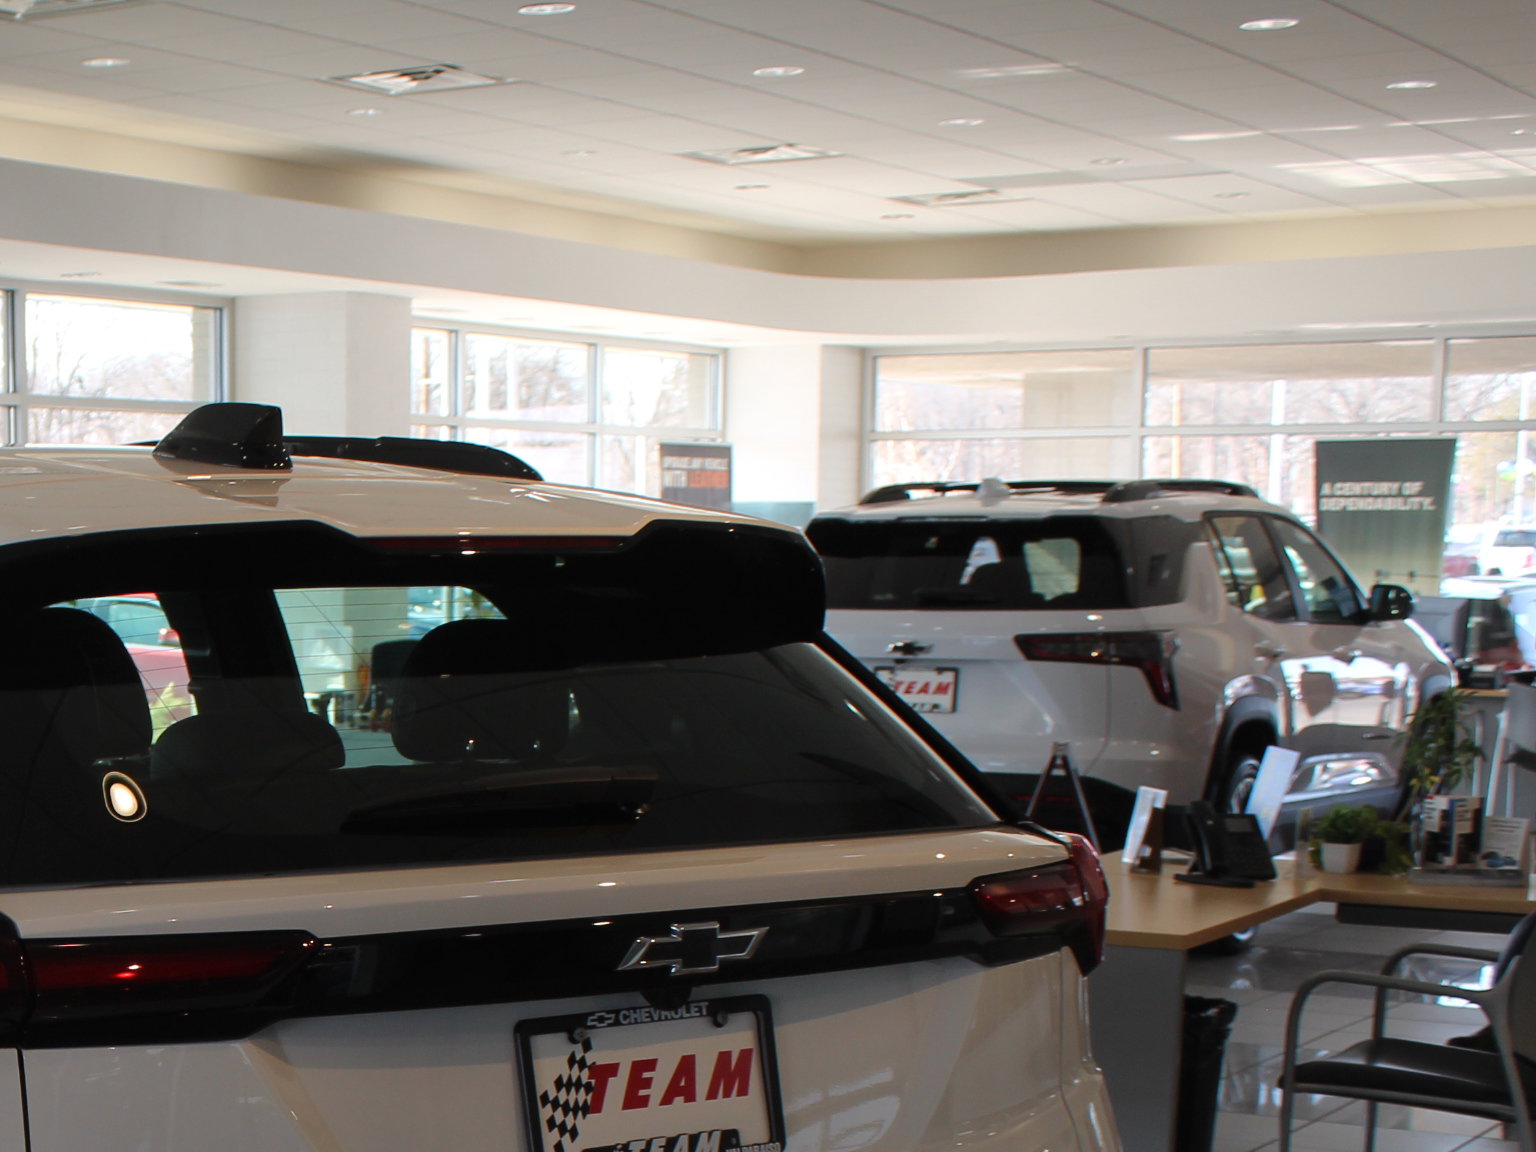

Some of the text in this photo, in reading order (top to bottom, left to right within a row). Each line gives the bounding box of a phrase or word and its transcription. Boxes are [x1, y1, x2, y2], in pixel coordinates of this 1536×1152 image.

[1320, 482, 1424, 496] A CENTURY OF
[1319, 497, 1437, 511] DEPENDABILITY.
[893, 681, 954, 695] TEAM
[585, 1047, 754, 1115] TEAM
